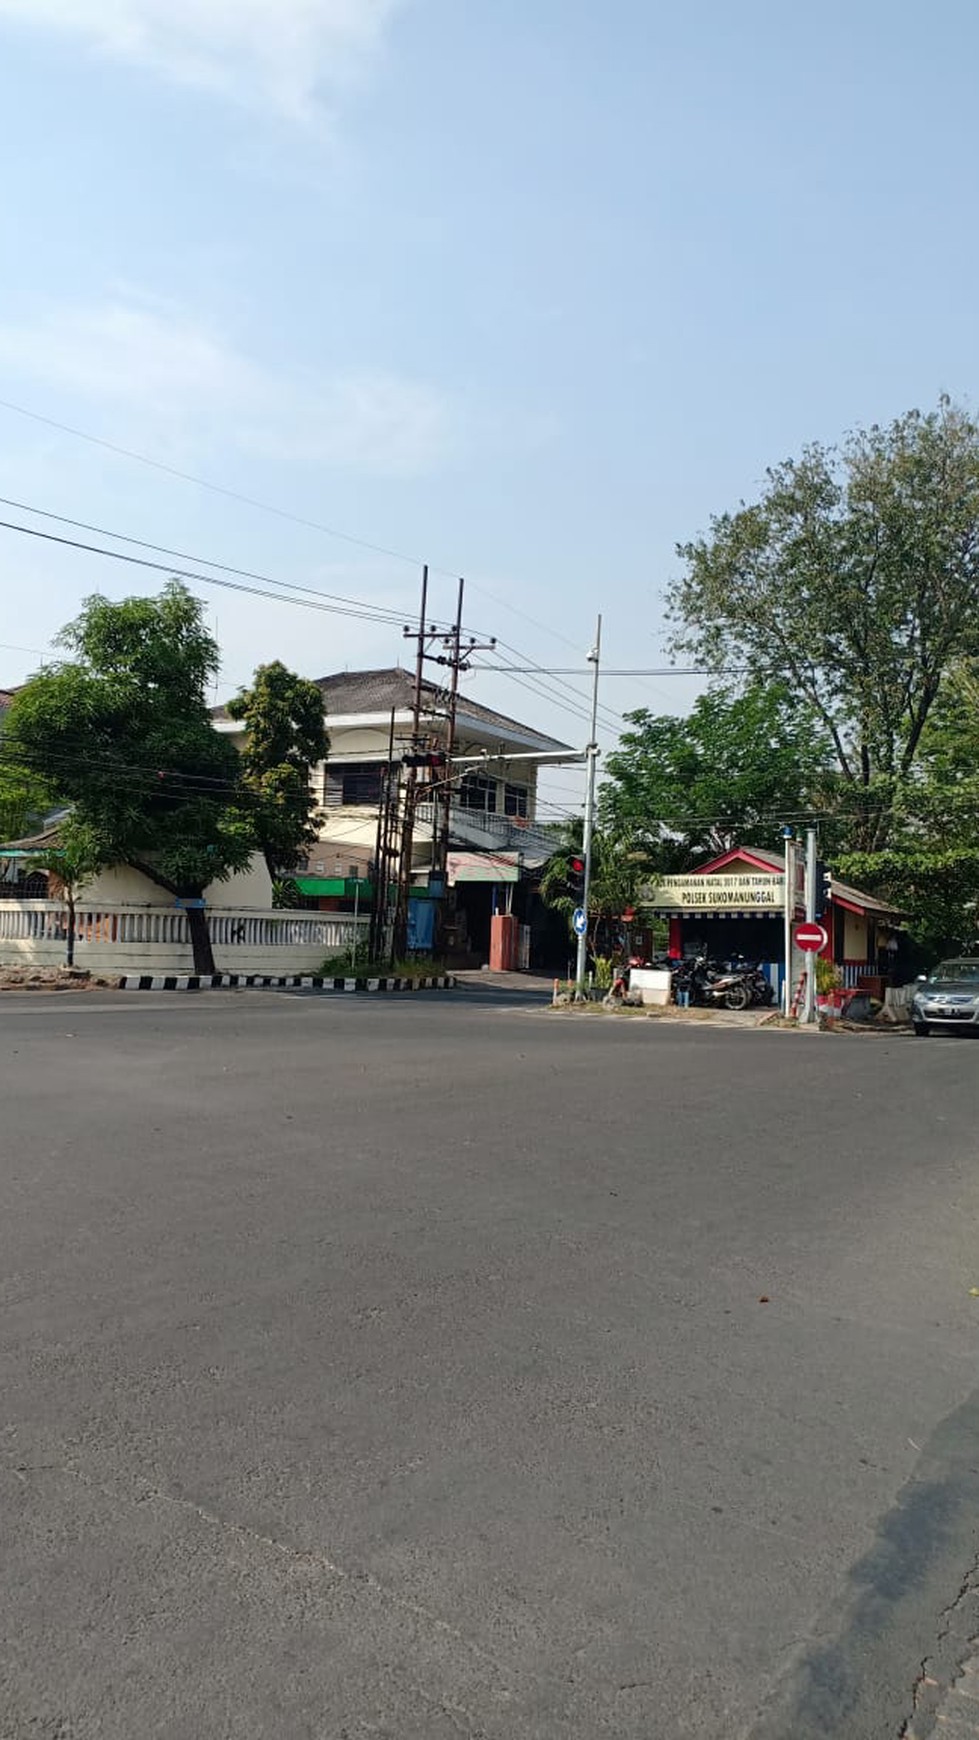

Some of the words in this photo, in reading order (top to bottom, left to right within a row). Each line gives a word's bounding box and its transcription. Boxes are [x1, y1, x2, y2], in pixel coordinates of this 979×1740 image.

[667, 878, 705, 887] PENGAMANAN
[706, 878, 722, 887] NATAL
[739, 877, 750, 886] DAN
[752, 877, 771, 886] TAHUN
[682, 892, 706, 904] POLSEK
[709, 891, 774, 904] SUKOMANUNGGAL
